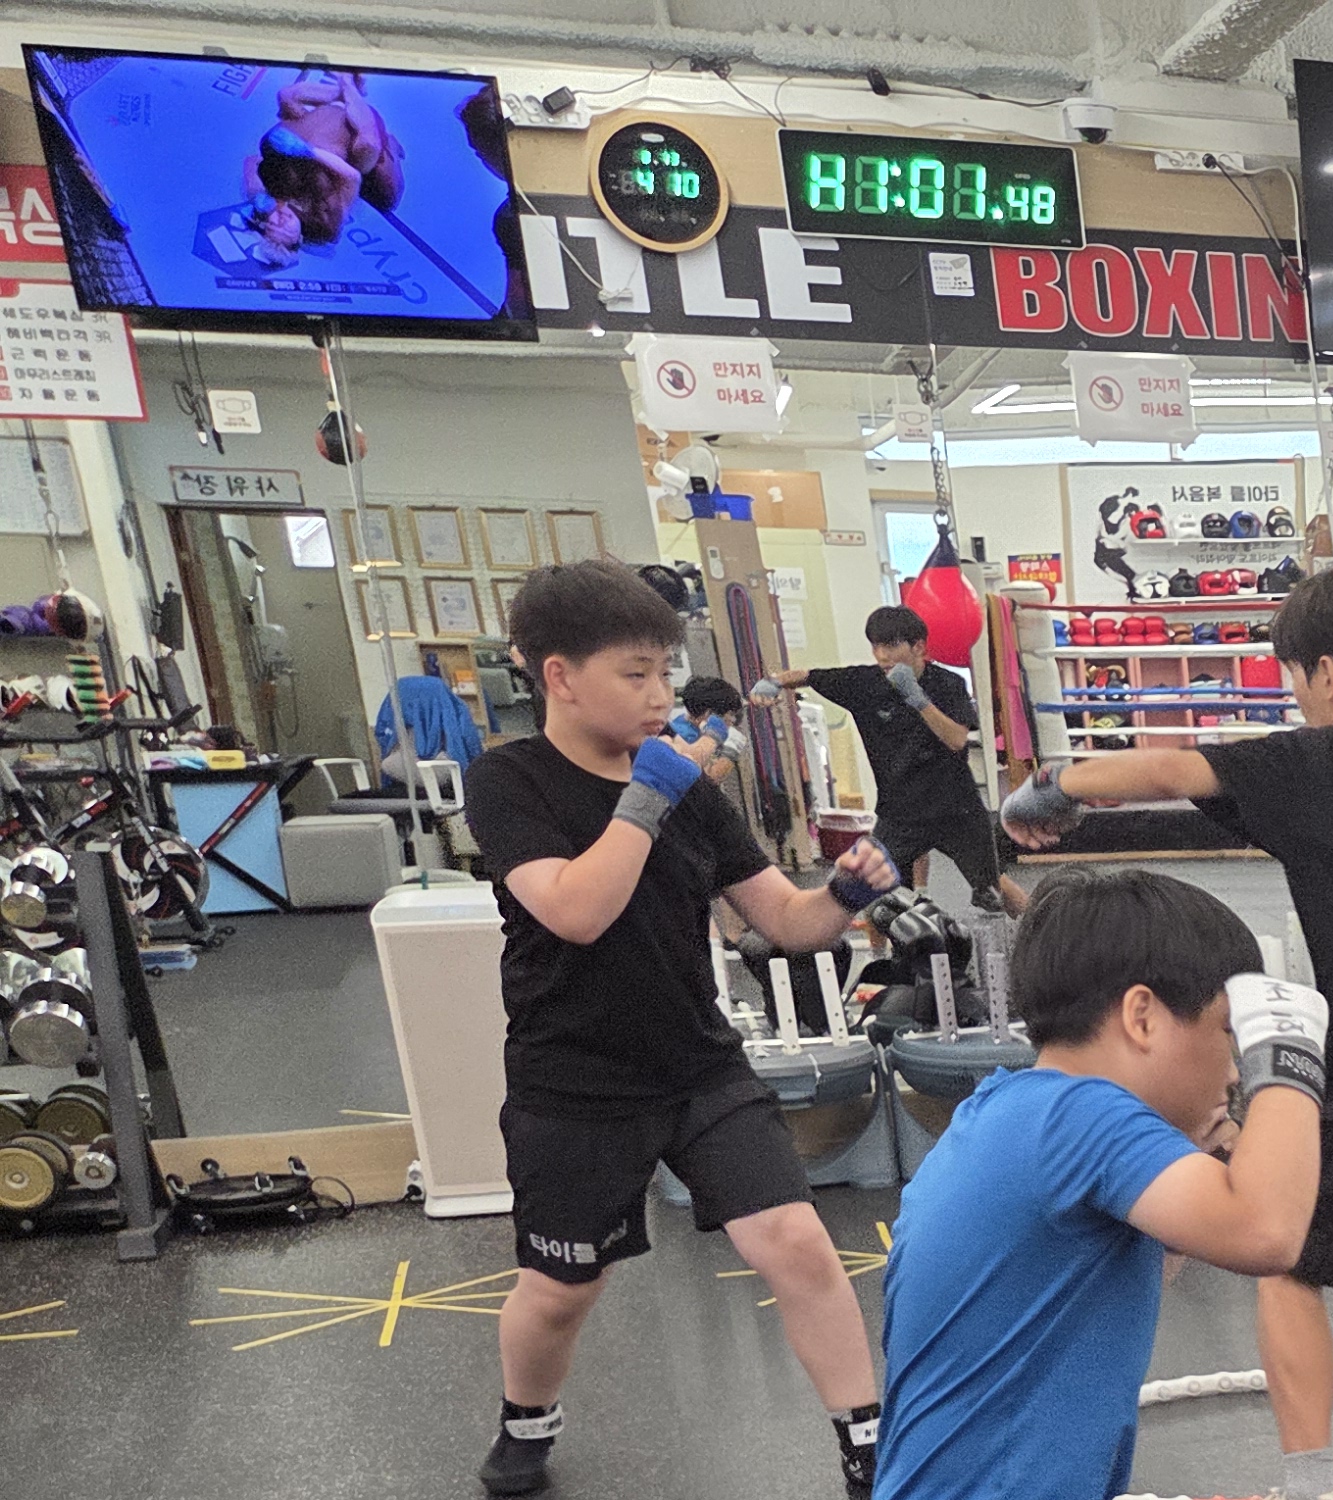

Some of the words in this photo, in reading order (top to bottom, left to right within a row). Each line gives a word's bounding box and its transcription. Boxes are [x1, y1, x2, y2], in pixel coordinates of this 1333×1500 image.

[519, 214, 852, 322] ITLE
[990, 244, 1308, 343] BOXIN
[713, 362, 761, 379] 만지지
[1138, 377, 1181, 394] 만지지
[717, 388, 766, 404] 마세요
[1141, 402, 1184, 418] 마세요
[529, 1232, 597, 1264] 타이틀
